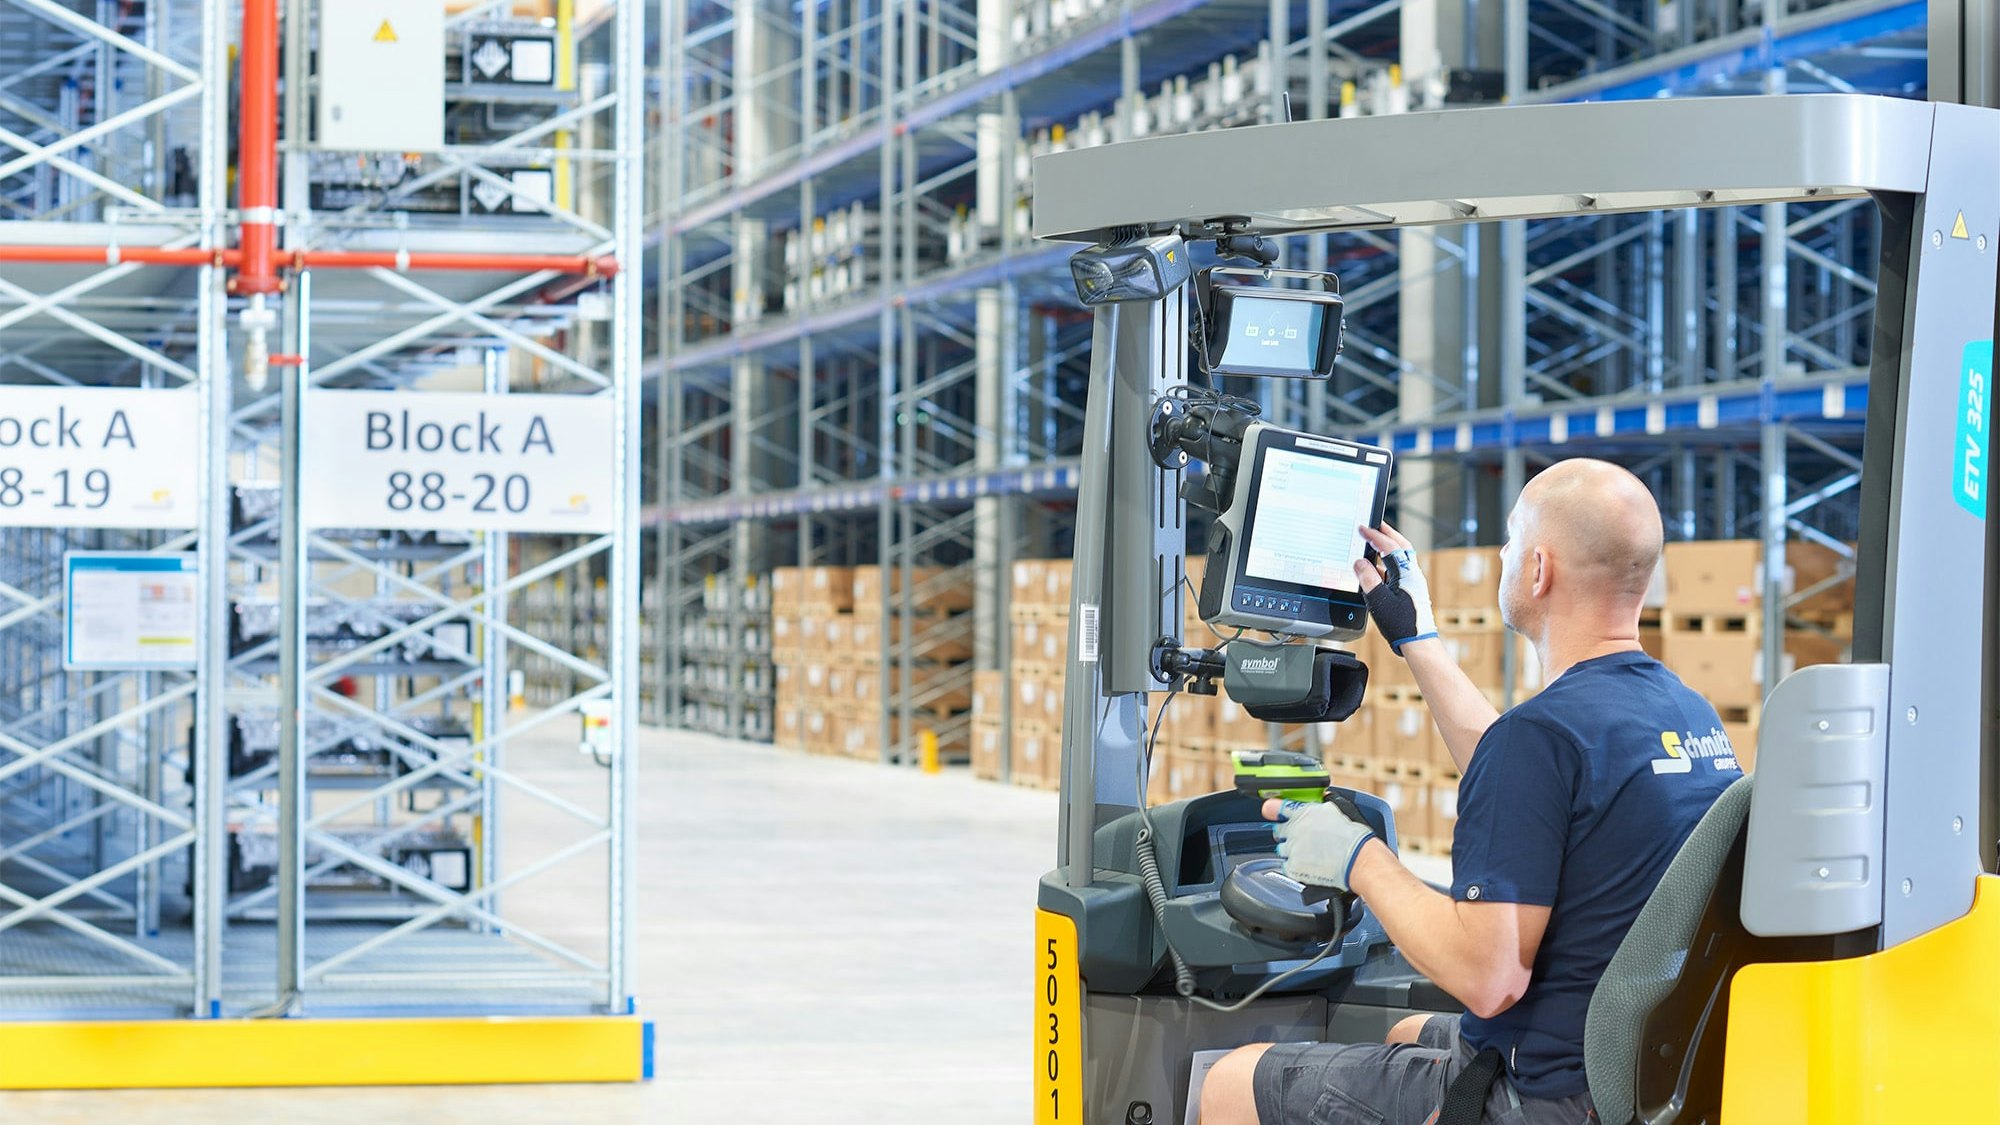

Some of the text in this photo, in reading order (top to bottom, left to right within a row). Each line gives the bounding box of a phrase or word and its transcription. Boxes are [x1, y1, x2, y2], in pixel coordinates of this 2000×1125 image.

[102, 410, 137, 449] A
[366, 409, 555, 454] Block A
[1963, 367, 1984, 501] ETV 325
[386, 470, 531, 513] 88-20
[1240, 656, 1279, 670] symbol
